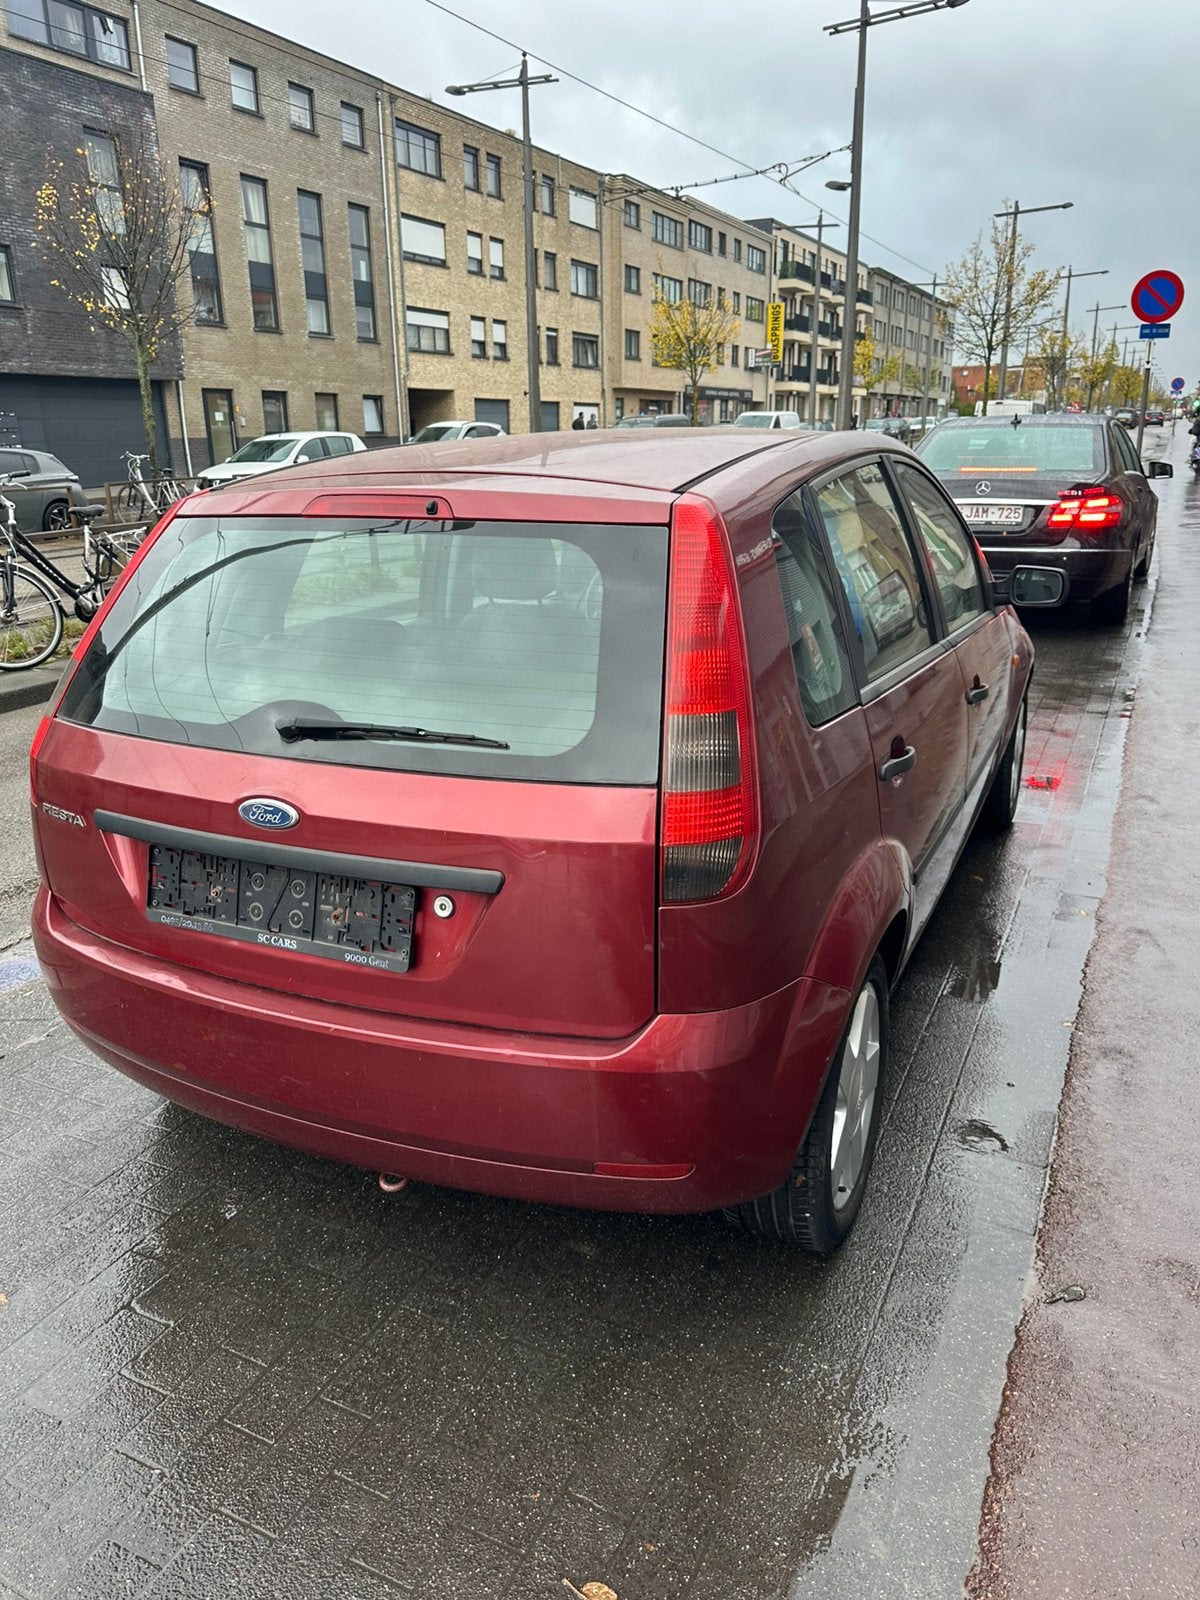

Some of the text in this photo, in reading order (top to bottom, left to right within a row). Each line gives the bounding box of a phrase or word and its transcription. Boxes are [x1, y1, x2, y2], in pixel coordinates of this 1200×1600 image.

[771, 304, 782, 360] BOXSPRINGS
[42, 802, 87, 827] FIESTA
[249, 804, 282, 825] Ford
[257, 933, 297, 950] SC CARS
[344, 952, 389, 969] 9000 Gent
